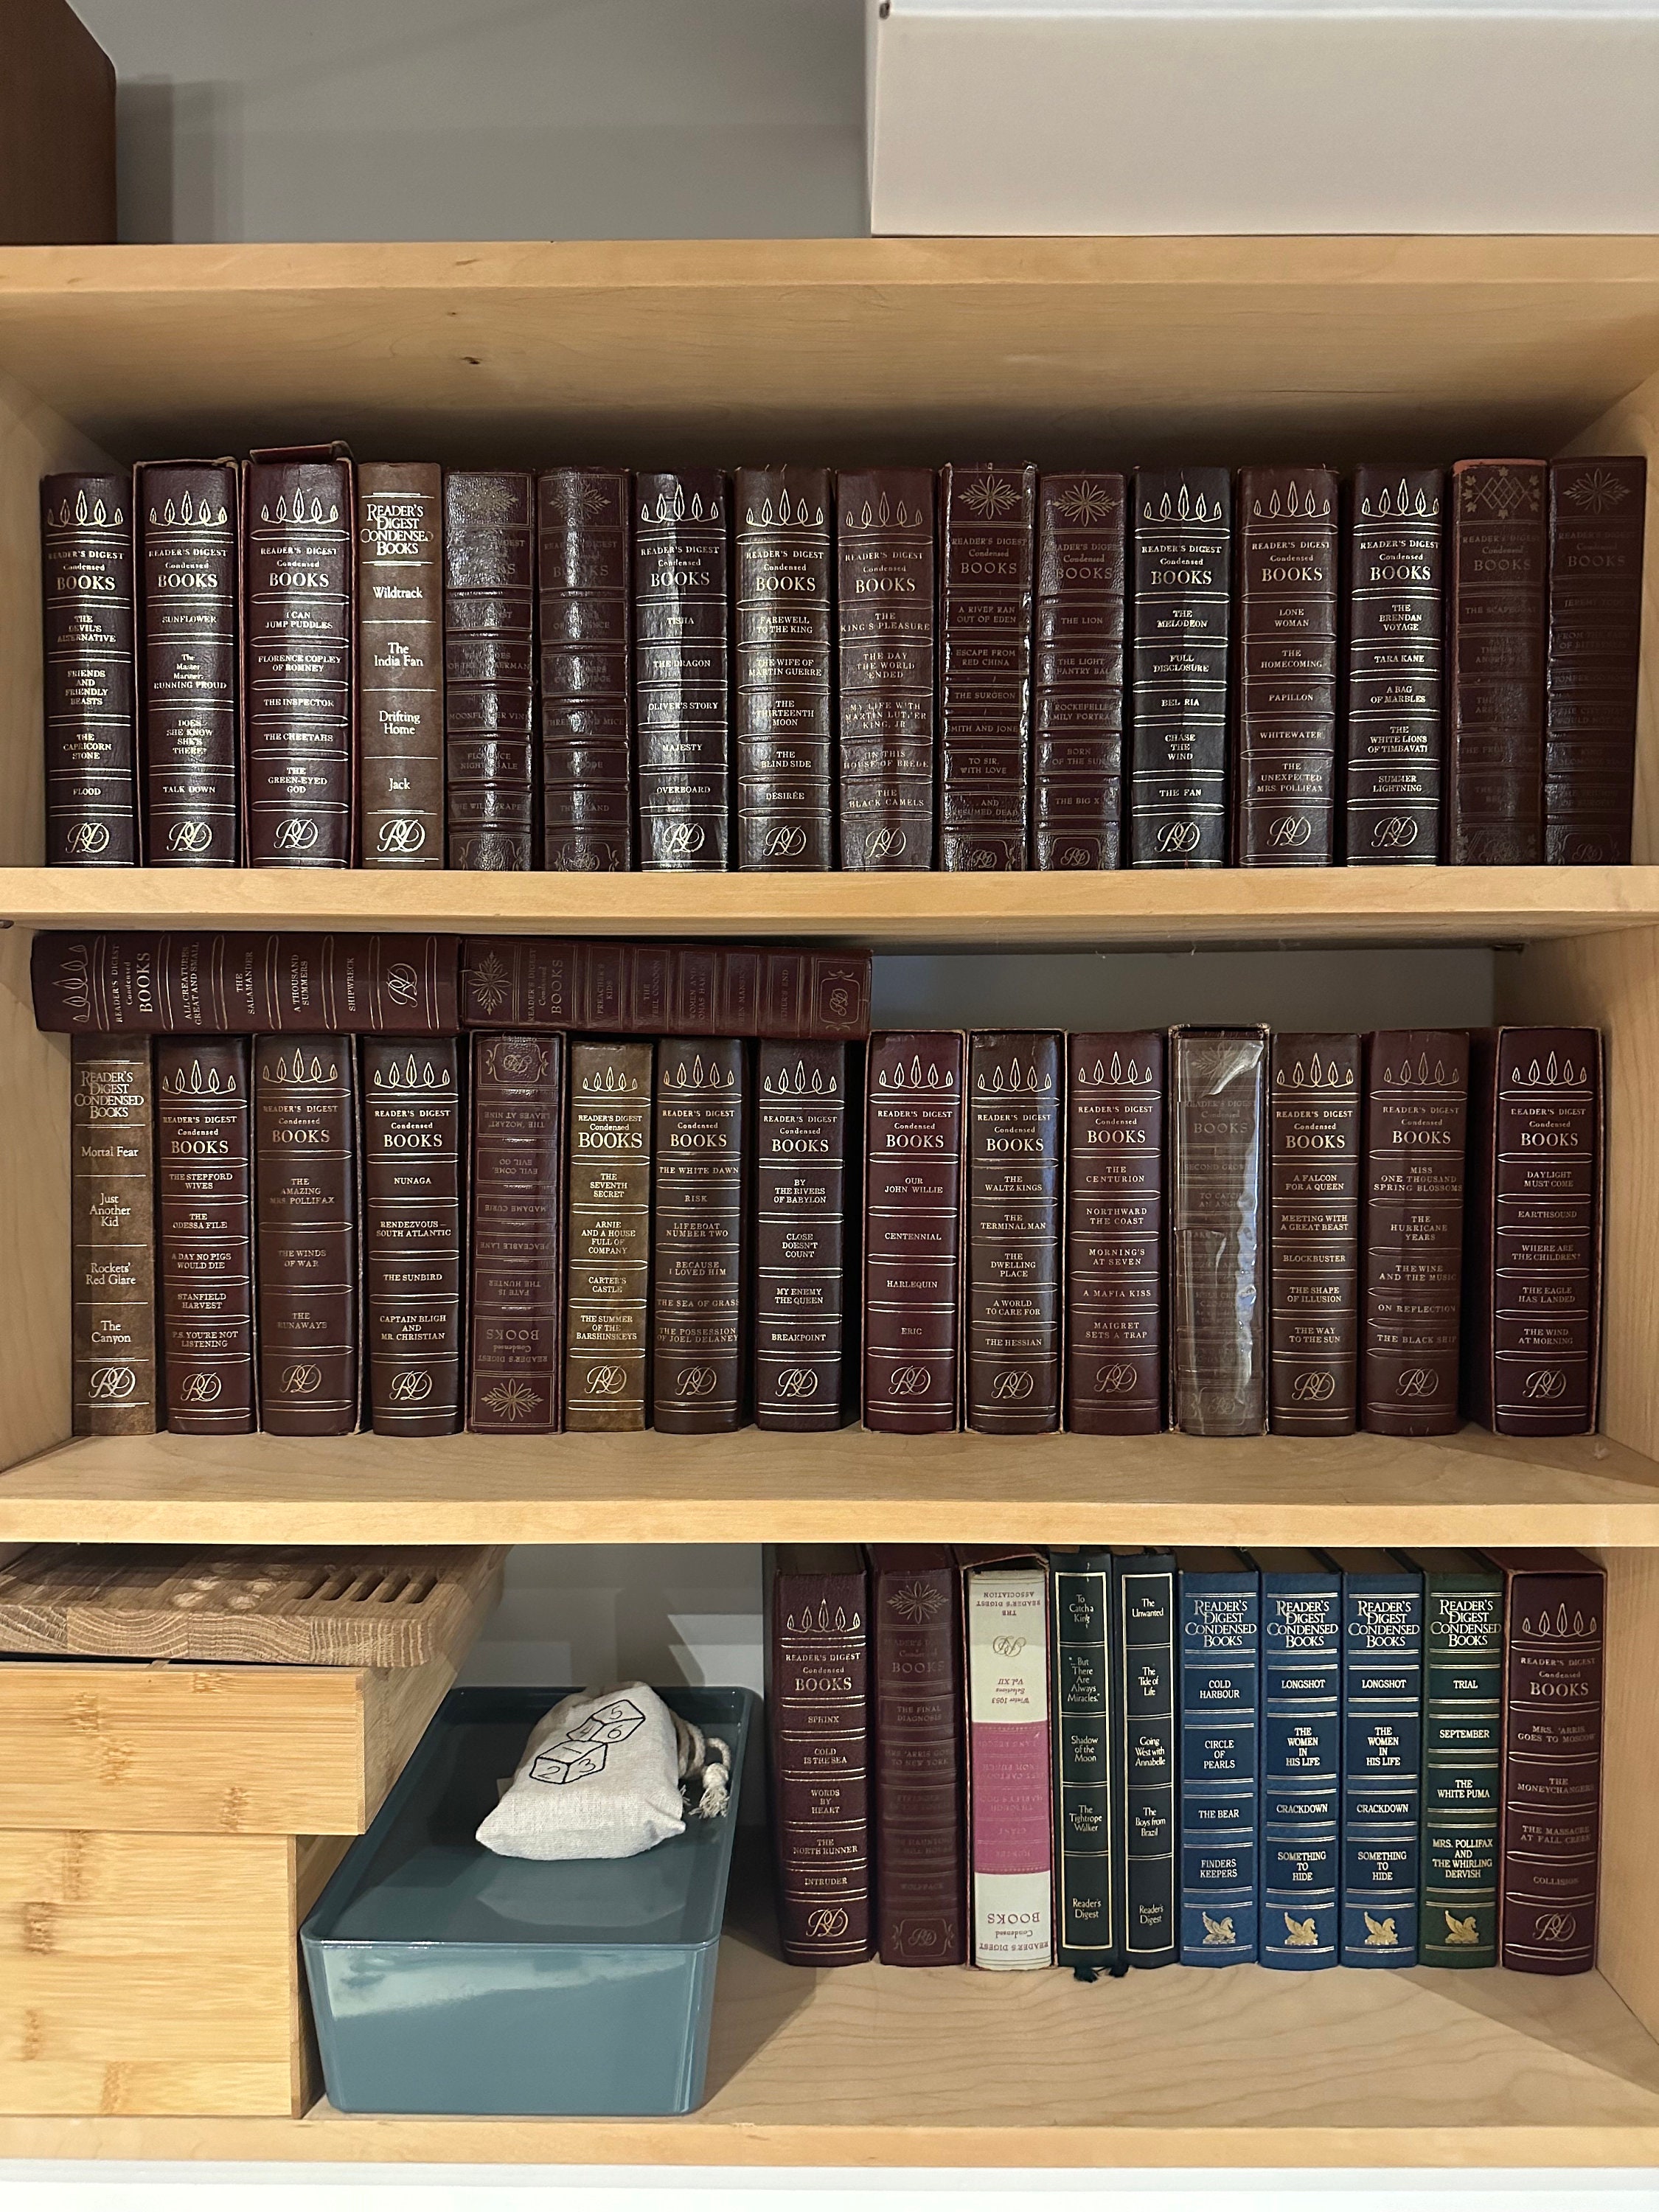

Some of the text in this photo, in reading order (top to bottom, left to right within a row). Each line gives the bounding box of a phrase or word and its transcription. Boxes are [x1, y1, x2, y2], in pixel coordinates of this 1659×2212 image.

[377, 540, 418, 555] BOOKS
[961, 563, 1016, 574] BOOKS
[1262, 567, 1322, 581] BOOKS
[1370, 566, 1430, 580] BOOKS
[159, 574, 218, 588] BOOKS
[270, 572, 329, 588] BOOKS
[651, 571, 709, 588] BOOKS
[1151, 570, 1211, 584] BOOKS
[58, 575, 115, 591] BOOKS
[757, 576, 815, 593] BOOKS
[856, 578, 915, 593] BOOKS
[372, 586, 422, 598] Wildtrack
[162, 614, 216, 625] SUNFLOWER
[759, 616, 810, 625] FAREWELL
[388, 642, 410, 655] The
[375, 655, 423, 667] India Fan
[1153, 664, 1208, 672] DISCLOSURE
[380, 711, 420, 726] Drifting
[383, 723, 415, 734] Home
[1165, 734, 1195, 742] CHASE
[759, 759, 787, 769] BLIND
[268, 776, 327, 786] GREEN-EYED
[389, 778, 411, 791] Jack
[74, 787, 101, 795] FLOOD
[187, 785, 215, 793] DOWN
[287, 785, 306, 794] GOD
[655, 785, 710, 794] OVERBOARD
[138, 953, 152, 1012] BOOKS
[246, 953, 254, 1014] SALAMANDER
[347, 959, 355, 1011] SHIPWRECK
[551, 960, 563, 1014] BOOKS
[74, 1093, 144, 1106] CONDENSED
[90, 1106, 128, 1119] BOOKS
[273, 1130, 330, 1143] BOOKS
[384, 1134, 442, 1147] BOOKS
[578, 1133, 642, 1148] BOOKS
[671, 1134, 726, 1147] BOOKS
[886, 1135, 943, 1147] BOOKS
[1088, 1130, 1145, 1143] BOOKS
[1286, 1135, 1345, 1148] BOOKS
[1393, 1131, 1450, 1144] BOOKS
[1521, 1133, 1578, 1146] BOOKS
[172, 1141, 228, 1154] BOOKS
[772, 1139, 828, 1152] BOOKS
[987, 1138, 1043, 1151] BOOKS
[82, 1146, 139, 1157] Mortal Fear
[100, 1193, 119, 1205] Just
[90, 1205, 131, 1215] Another
[101, 1216, 119, 1226] Kid
[91, 1262, 131, 1273] Rockets'
[86, 1274, 136, 1284] Red Glare
[887, 1280, 937, 1288] HARLEQUIN
[91, 1332, 131, 1344] Canyon
[487, 1329, 539, 1340] BOOKS
[1133, 1607, 1164, 1617] Unwanted
[1430, 1622, 1500, 1635] CONDENSED
[1204, 1635, 1242, 1647] BOOKS
[796, 1677, 852, 1691] BOOKS
[1208, 1680, 1231, 1688] COLD
[1281, 1680, 1325, 1688] LONGSHOT
[1453, 1680, 1478, 1688] TRIAL
[1531, 1682, 1588, 1697] BOOKS
[1200, 1690, 1239, 1698] HARBOUR
[609, 1705, 623, 1719] 5
[580, 1726, 593, 1737] 4
[608, 1725, 623, 1739] 6
[1439, 1730, 1489, 1738] SEPTEMBER
[1071, 1736, 1098, 1744] Shadow
[1140, 1736, 1160, 1746] Going
[1205, 1740, 1234, 1748] CIRCLE
[1368, 1737, 1399, 1745] WOMEN
[814, 1748, 836, 1756] COLD
[1075, 1753, 1096, 1761] Moon
[1214, 1750, 1225, 1759] OF
[578, 1759, 596, 1773] 3
[1135, 1756, 1165, 1766] Annabelle
[1204, 1760, 1235, 1769] PEARLS
[538, 1766, 560, 1779] 2
[1437, 1790, 1489, 1798] WHITE PUMA
[1198, 1809, 1239, 1818] THE BEAR
[1276, 1804, 1327, 1813] CRACKDOWN
[1069, 1813, 1102, 1823] Tightrope
[1074, 1823, 1098, 1832] Walker
[1141, 1827, 1158, 1836] Brazil
[1200, 1869, 1237, 1878] KEEPERS
[1293, 1872, 1312, 1881] HIDE
[1445, 1870, 1481, 1878] DERVISH
[804, 1877, 847, 1886] INTRUDER
[1073, 1898, 1101, 1907] Reader's
[987, 1912, 1040, 1924] BOOKS
[1075, 1909, 1099, 1920] Digest
[995, 1930, 1033, 1939] Condensed
